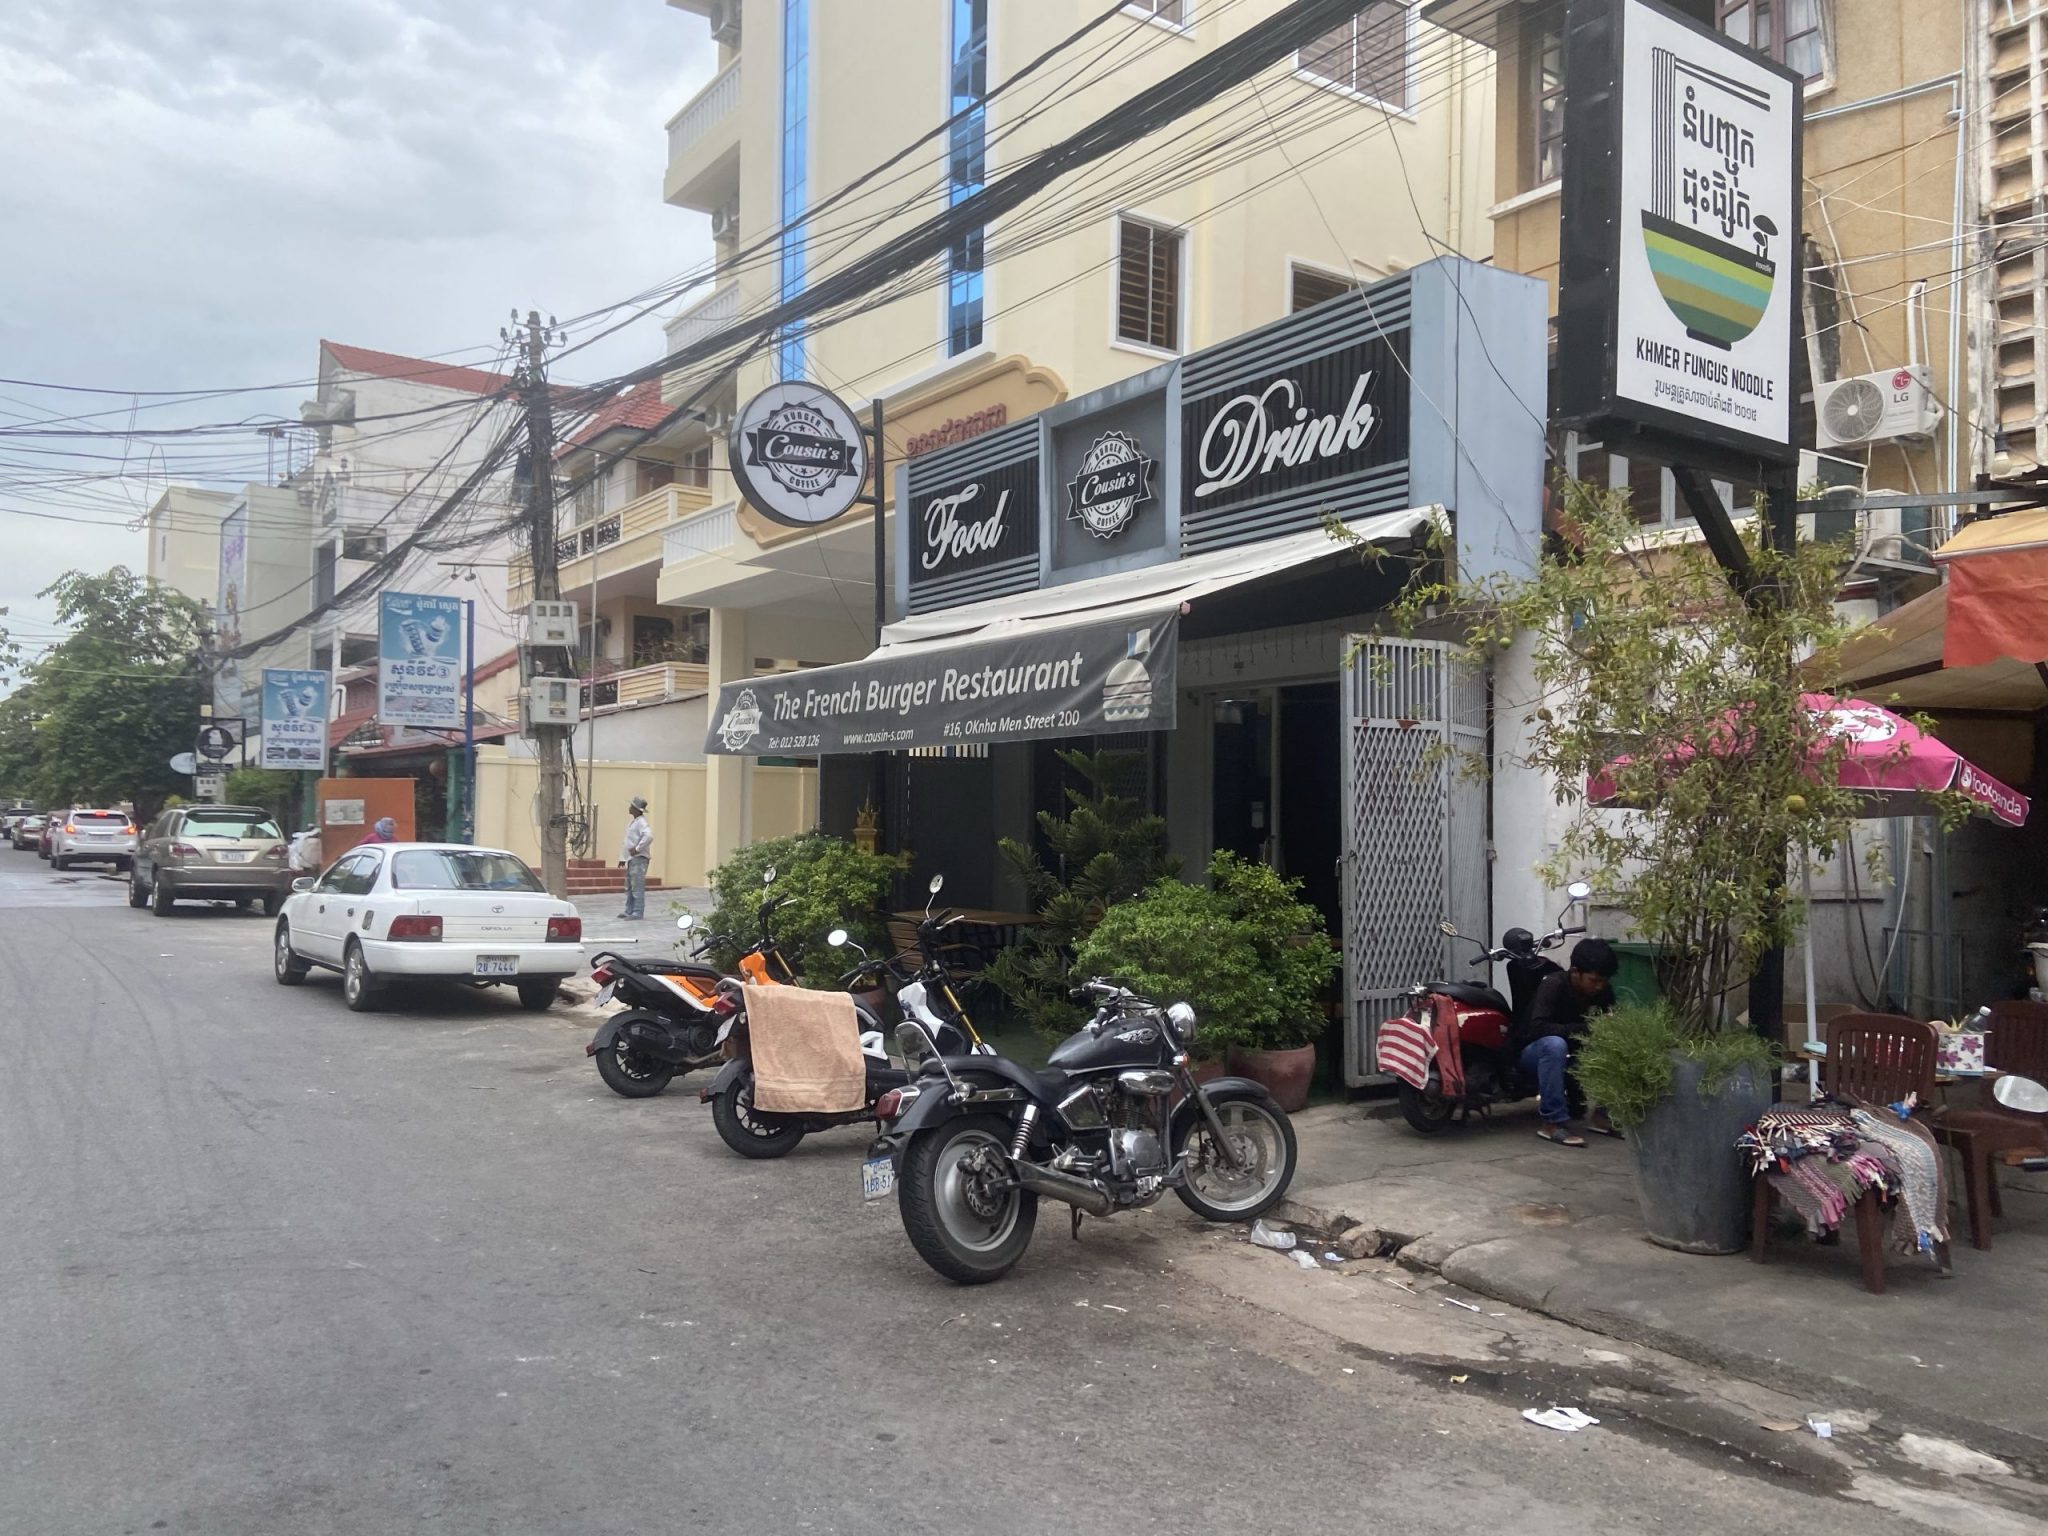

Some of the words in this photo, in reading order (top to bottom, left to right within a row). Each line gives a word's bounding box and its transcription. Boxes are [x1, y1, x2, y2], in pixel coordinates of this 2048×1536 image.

[1636, 336, 1680, 371] KHMER
[1683, 351, 1728, 386] FUNGUS
[1731, 367, 1774, 401] NOODLE
[1893, 392, 1909, 403] LG
[784, 411, 822, 428] BURGER
[1194, 370, 1375, 497] Drink
[765, 434, 840, 461] Cousin's
[1095, 442, 1123, 462] BURGER
[789, 476, 820, 489] COFFEE
[1081, 472, 1136, 505] Cousin's
[921, 483, 1011, 570] Food
[1096, 512, 1120, 527] COFFEE
[773, 690, 801, 721] The
[804, 681, 861, 718] French
[865, 678, 937, 716] Burger
[940, 651, 1084, 703] Restaurant
[943, 721, 962, 738] #16,
[965, 718, 996, 735] OKnha
[999, 717, 1021, 732] Men
[1023, 713, 1056, 730] Street
[1058, 710, 1080, 727] 200
[768, 737, 779, 749] Tel:
[780, 737, 794, 748] 012
[794, 736, 806, 747] 528
[806, 734, 820, 747] 126
[843, 728, 914, 745] www.cousin-s.com
